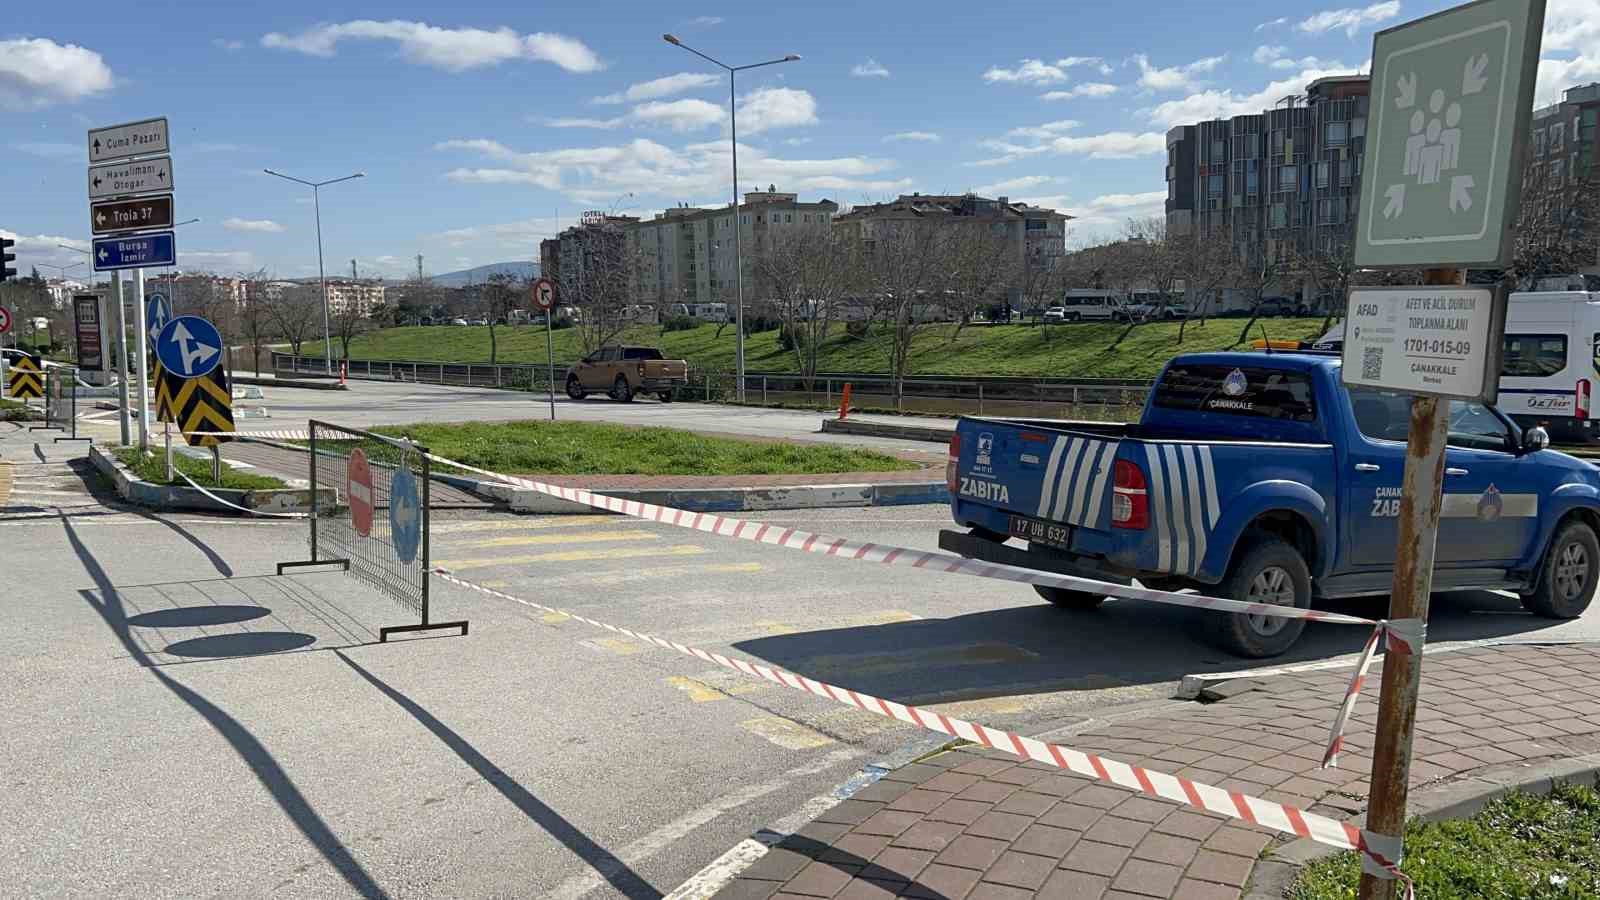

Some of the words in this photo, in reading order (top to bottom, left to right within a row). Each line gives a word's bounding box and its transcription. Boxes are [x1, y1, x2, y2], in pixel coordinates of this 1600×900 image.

[106, 136, 129, 149] Cuma
[113, 179, 144, 190] Otogar
[141, 207, 153, 219] 37
[119, 242, 147, 251] Bursa
[1356, 304, 1378, 316] AFAD
[1423, 298, 1431, 310] VE
[1448, 298, 1476, 311] DURUM
[1409, 317, 1445, 330] TOPLANMA
[1447, 318, 1469, 331] ALANI
[1403, 338, 1471, 355] 1701-015-09
[960, 478, 1009, 504] ZABITA
[1376, 487, 1402, 499] ÇANAK
[1370, 499, 1401, 517] ZAB
[1017, 519, 1028, 532] 17
[1047, 526, 1066, 543] 632
